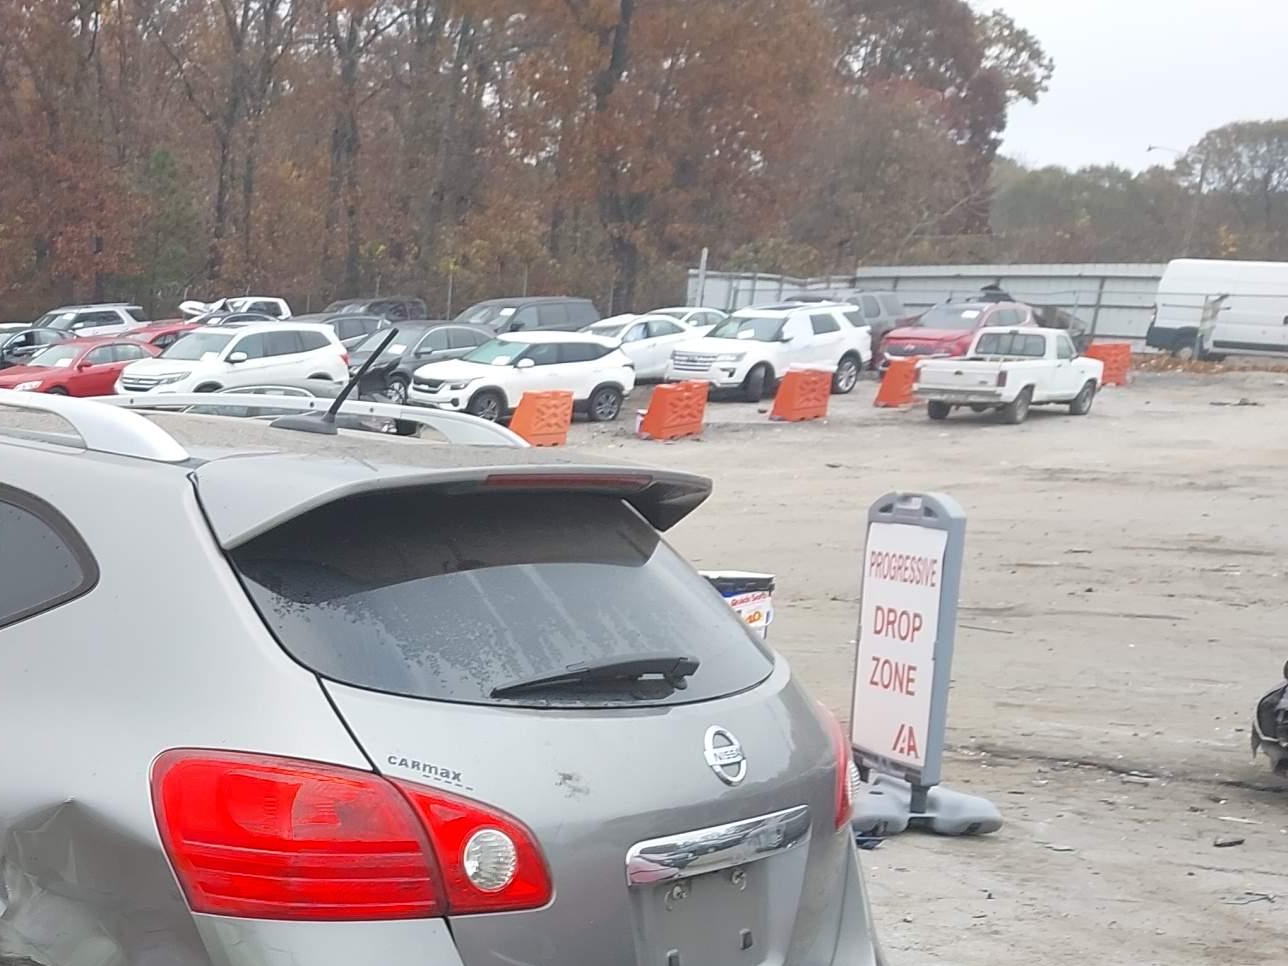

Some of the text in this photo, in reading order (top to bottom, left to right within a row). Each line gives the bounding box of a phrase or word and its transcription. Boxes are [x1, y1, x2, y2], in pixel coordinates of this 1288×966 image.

[869, 551, 937, 587] PROGRESSIVE
[873, 605, 923, 643] DROP
[869, 656, 917, 696] ZONE
